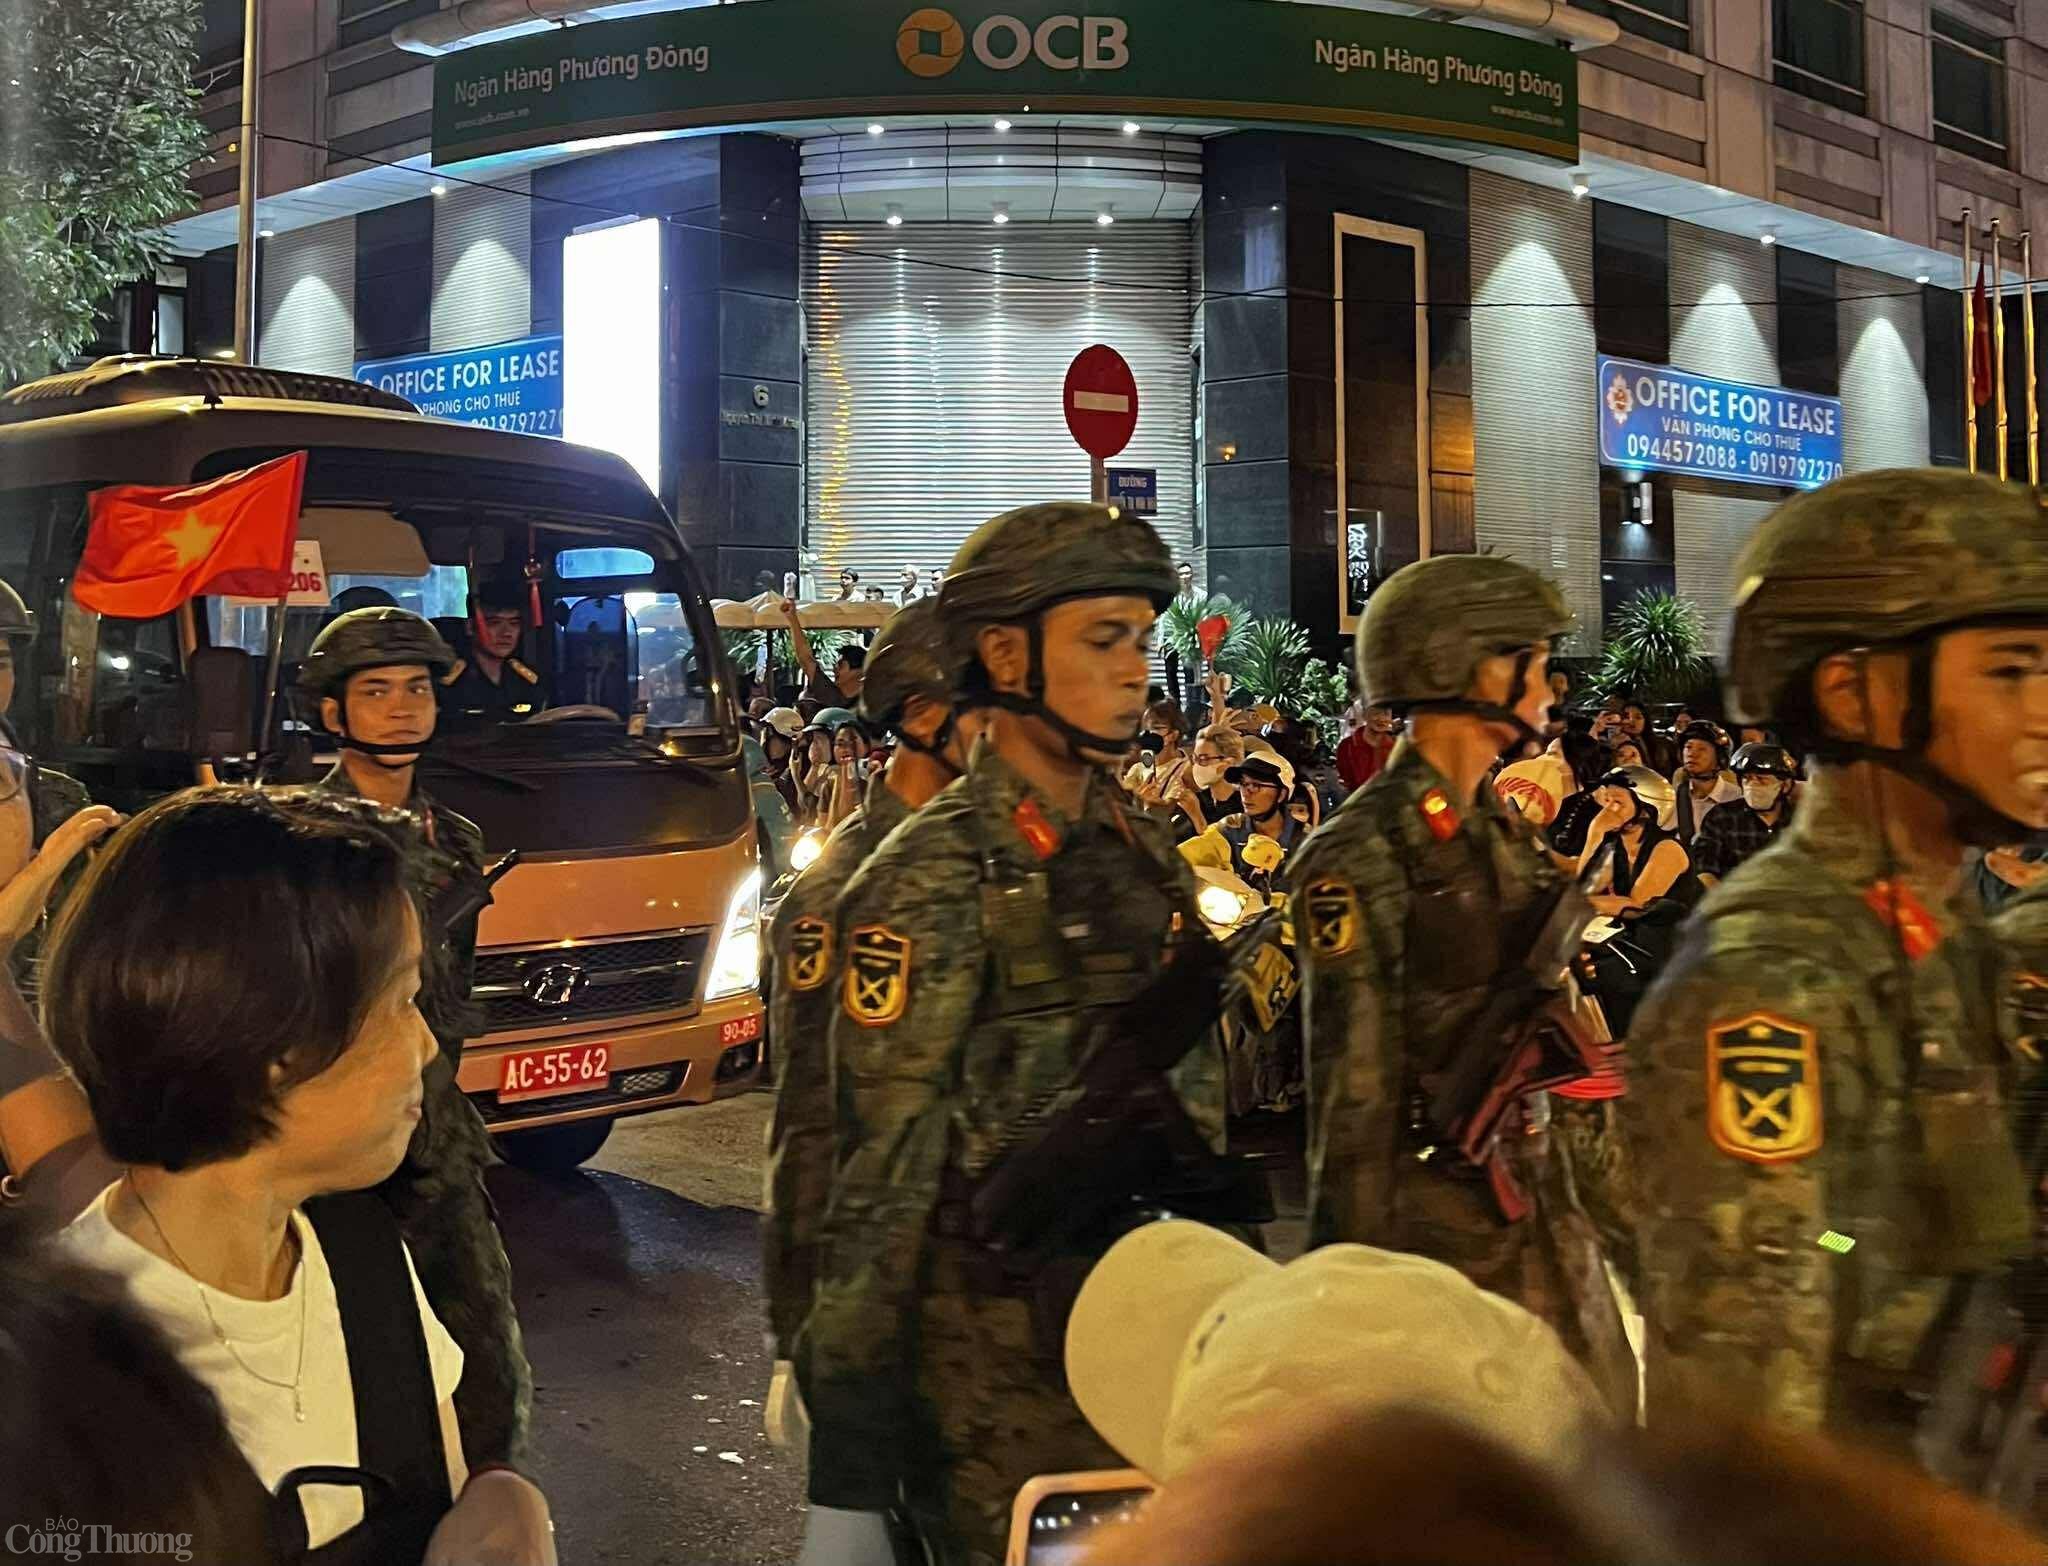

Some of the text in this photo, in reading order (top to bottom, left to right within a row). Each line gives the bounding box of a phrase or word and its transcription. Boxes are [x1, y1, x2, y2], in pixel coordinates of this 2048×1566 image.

[972, 14, 1130, 70] OCB
[455, 44, 709, 107] Ngân Hàng Phương Đông
[1315, 39, 1563, 107] Ngân Hàng Phương Đông
[380, 350, 560, 396] OFFICE FOR LEASE
[753, 384, 769, 407] 6
[464, 395, 491, 412] CHO
[1636, 376, 1836, 436] OFFICE FOR LEASE
[1627, 433, 1737, 469] 0944572088
[1750, 450, 1844, 481] 0919797270
[1744, 429, 1772, 447] CHO
[505, 1048, 608, 1090] AC-55-62
